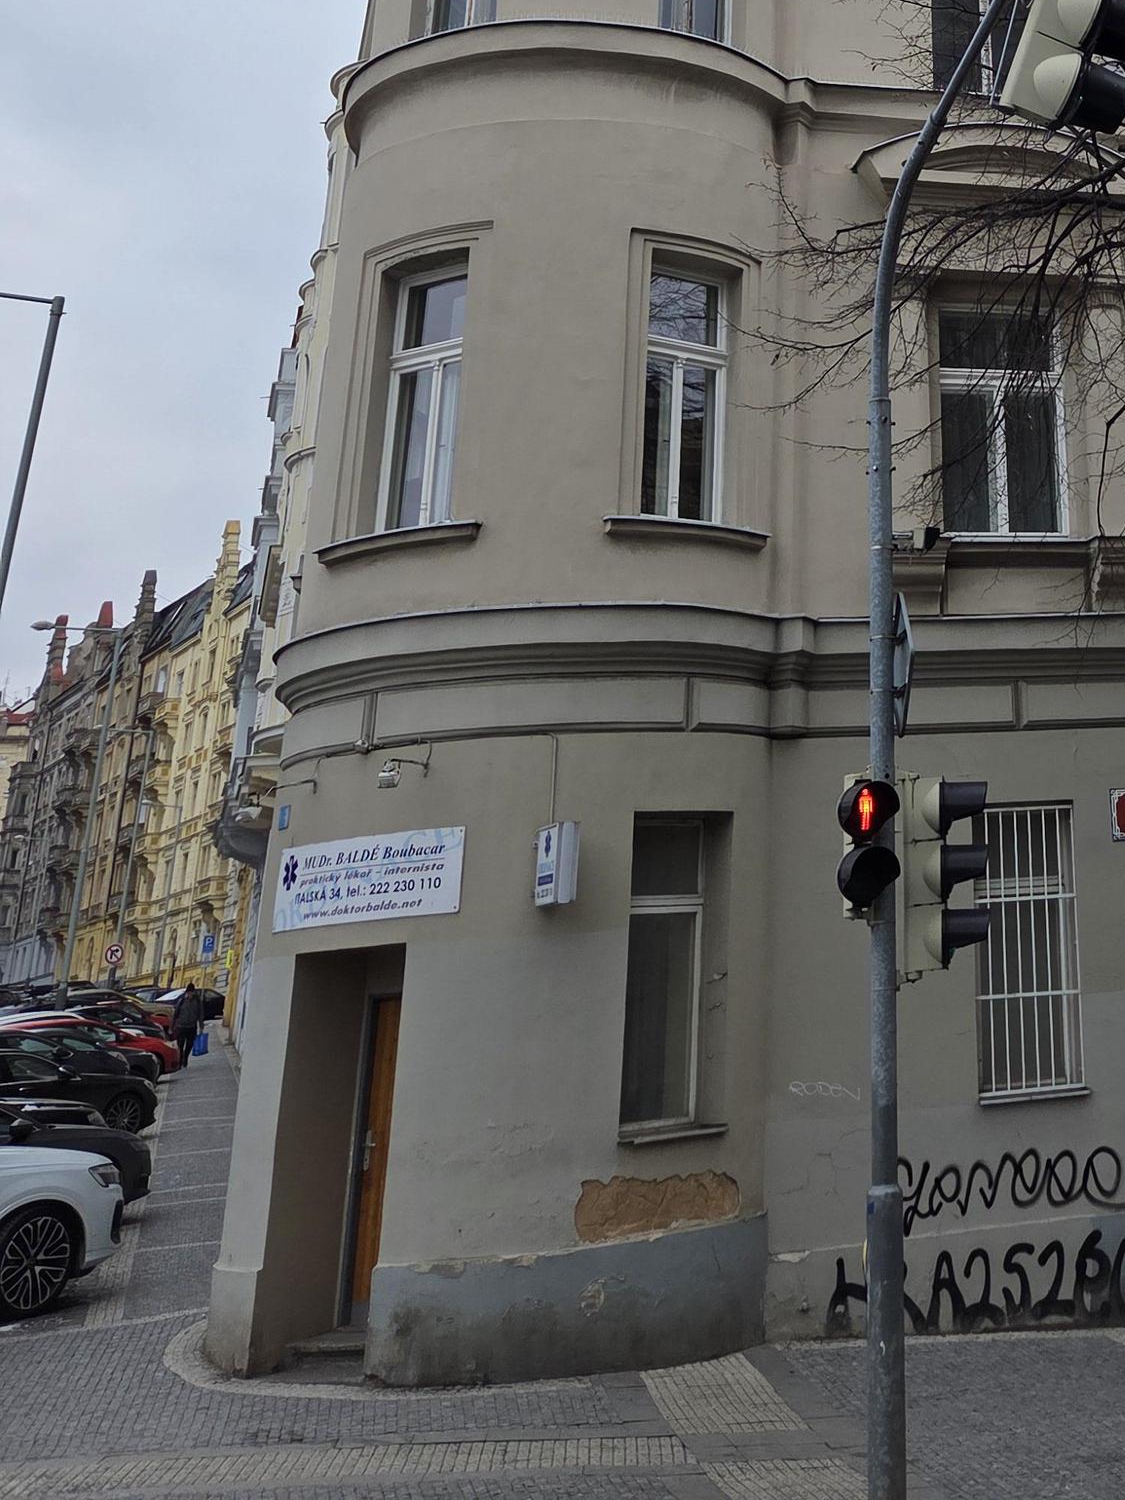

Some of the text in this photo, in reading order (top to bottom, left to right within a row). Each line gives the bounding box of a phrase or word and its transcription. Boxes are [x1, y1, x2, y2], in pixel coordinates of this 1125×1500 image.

[303, 844, 446, 871] MUDr. BALDÉ Boubacar
[299, 872, 341, 889] praktický
[343, 868, 373, 882] lékař
[383, 863, 444, 876] internista
[294, 876, 442, 906] ITALSKÁ 34, tel.: 222 230 110
[303, 898, 423, 920] www.doktorbalde.net
